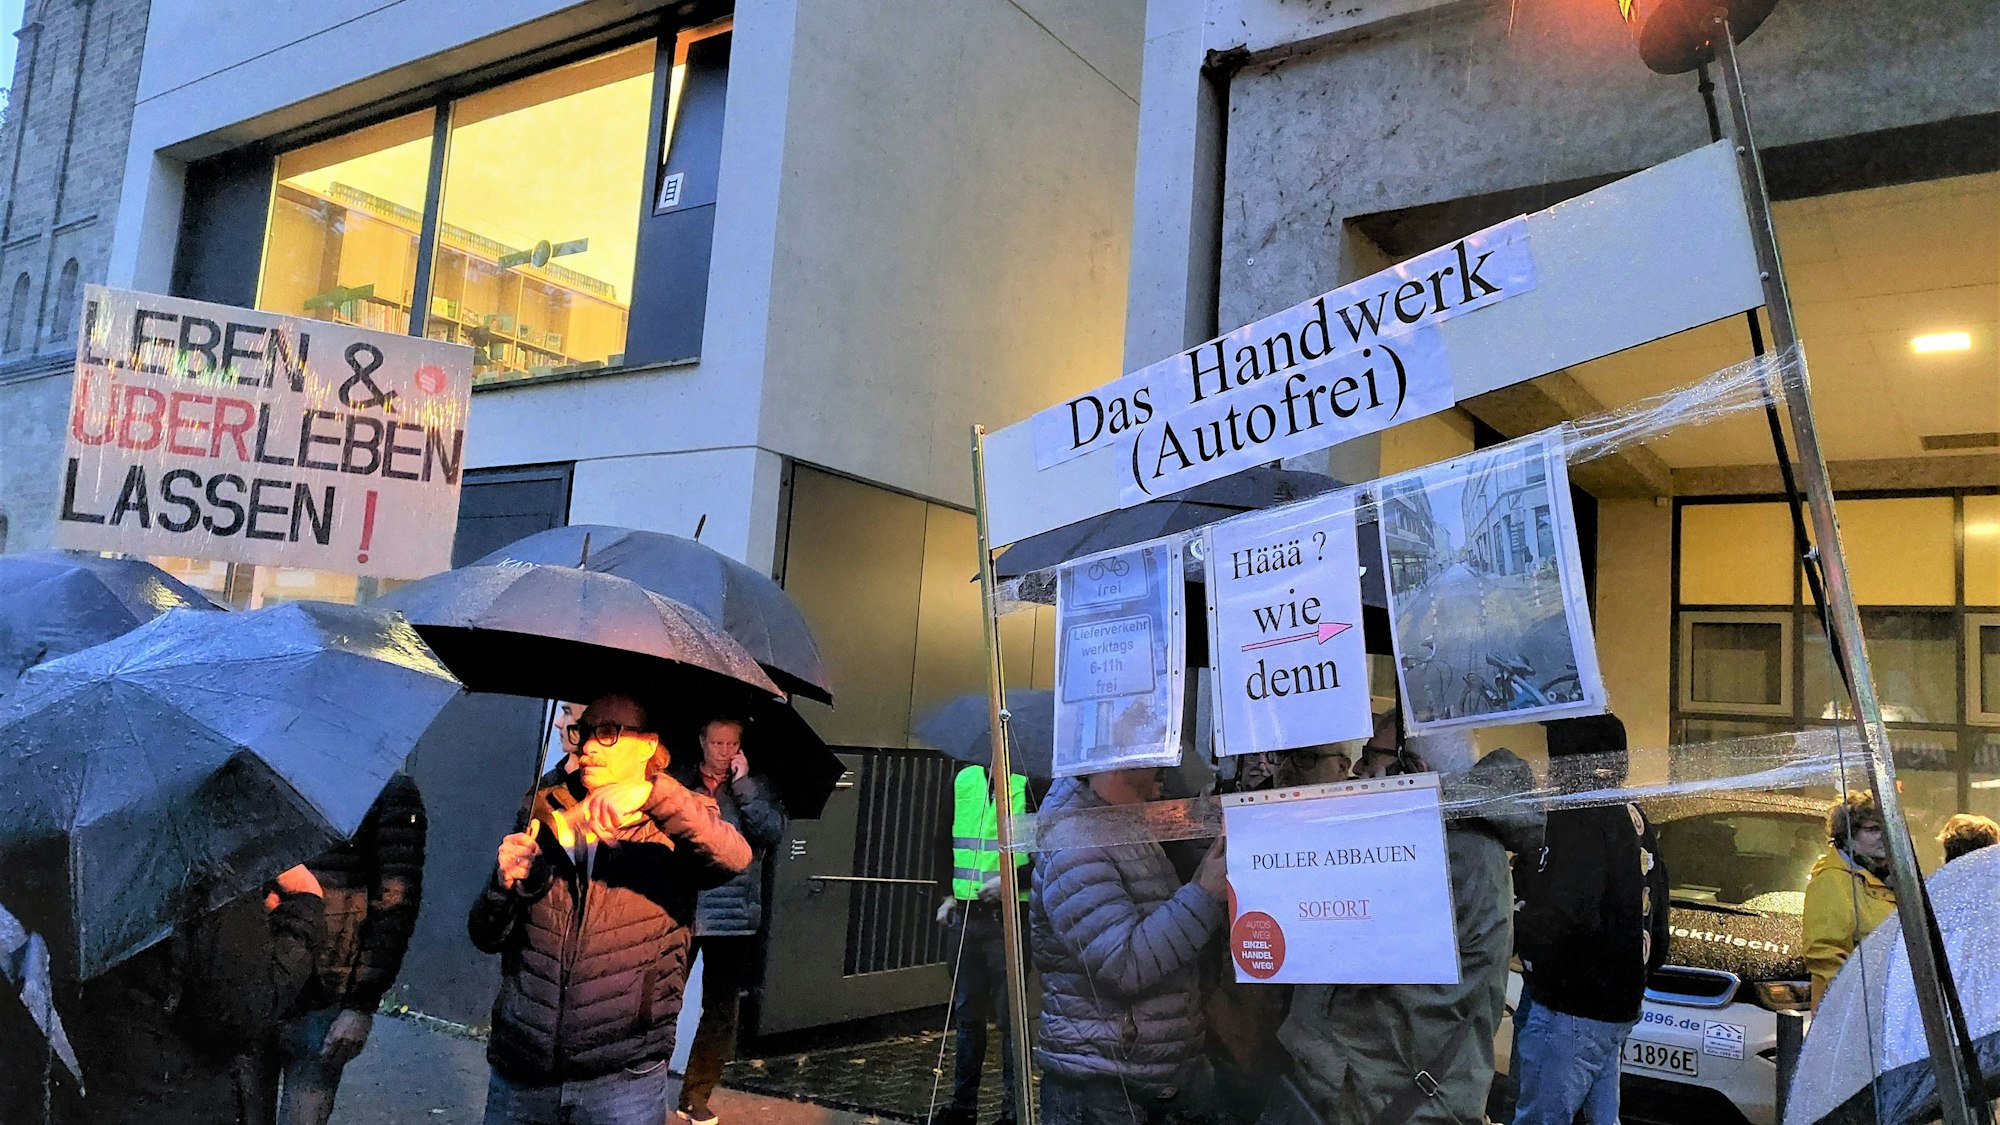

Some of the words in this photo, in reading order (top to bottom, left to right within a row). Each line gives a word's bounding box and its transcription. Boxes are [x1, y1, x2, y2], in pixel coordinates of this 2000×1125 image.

[84, 303, 311, 393] LEBEN
[339, 343, 397, 413] &
[1066, 384, 1154, 451] Das
[1186, 240, 1502, 404] Handwerk
[71, 368, 464, 486] ÜBERLEBEN
[1131, 344, 1407, 496] (Autofrei)
[61, 457, 336, 546] LASSEN
[1231, 540, 1303, 581] Häää
[1312, 531, 1328, 562] ?
[1253, 588, 1322, 634] wie
[1073, 620, 1148, 641] Lieferverkehr
[1081, 640, 1134, 657] werktags
[1089, 658, 1124, 675] 6-11h
[1246, 658, 1342, 701] denn
[1096, 678, 1118, 694] frei
[1252, 851, 1319, 870] POLLER
[1324, 844, 1418, 867] ABBAUEN
[1298, 899, 1371, 918] SOFORT
[1246, 920, 1272, 929] AUTOS
[1242, 940, 1273, 949] EINZEL-
[1668, 925, 1790, 955] lektrisch!
[1241, 950, 1274, 960] HANDEL
[1251, 961, 1275, 970] WEG!
